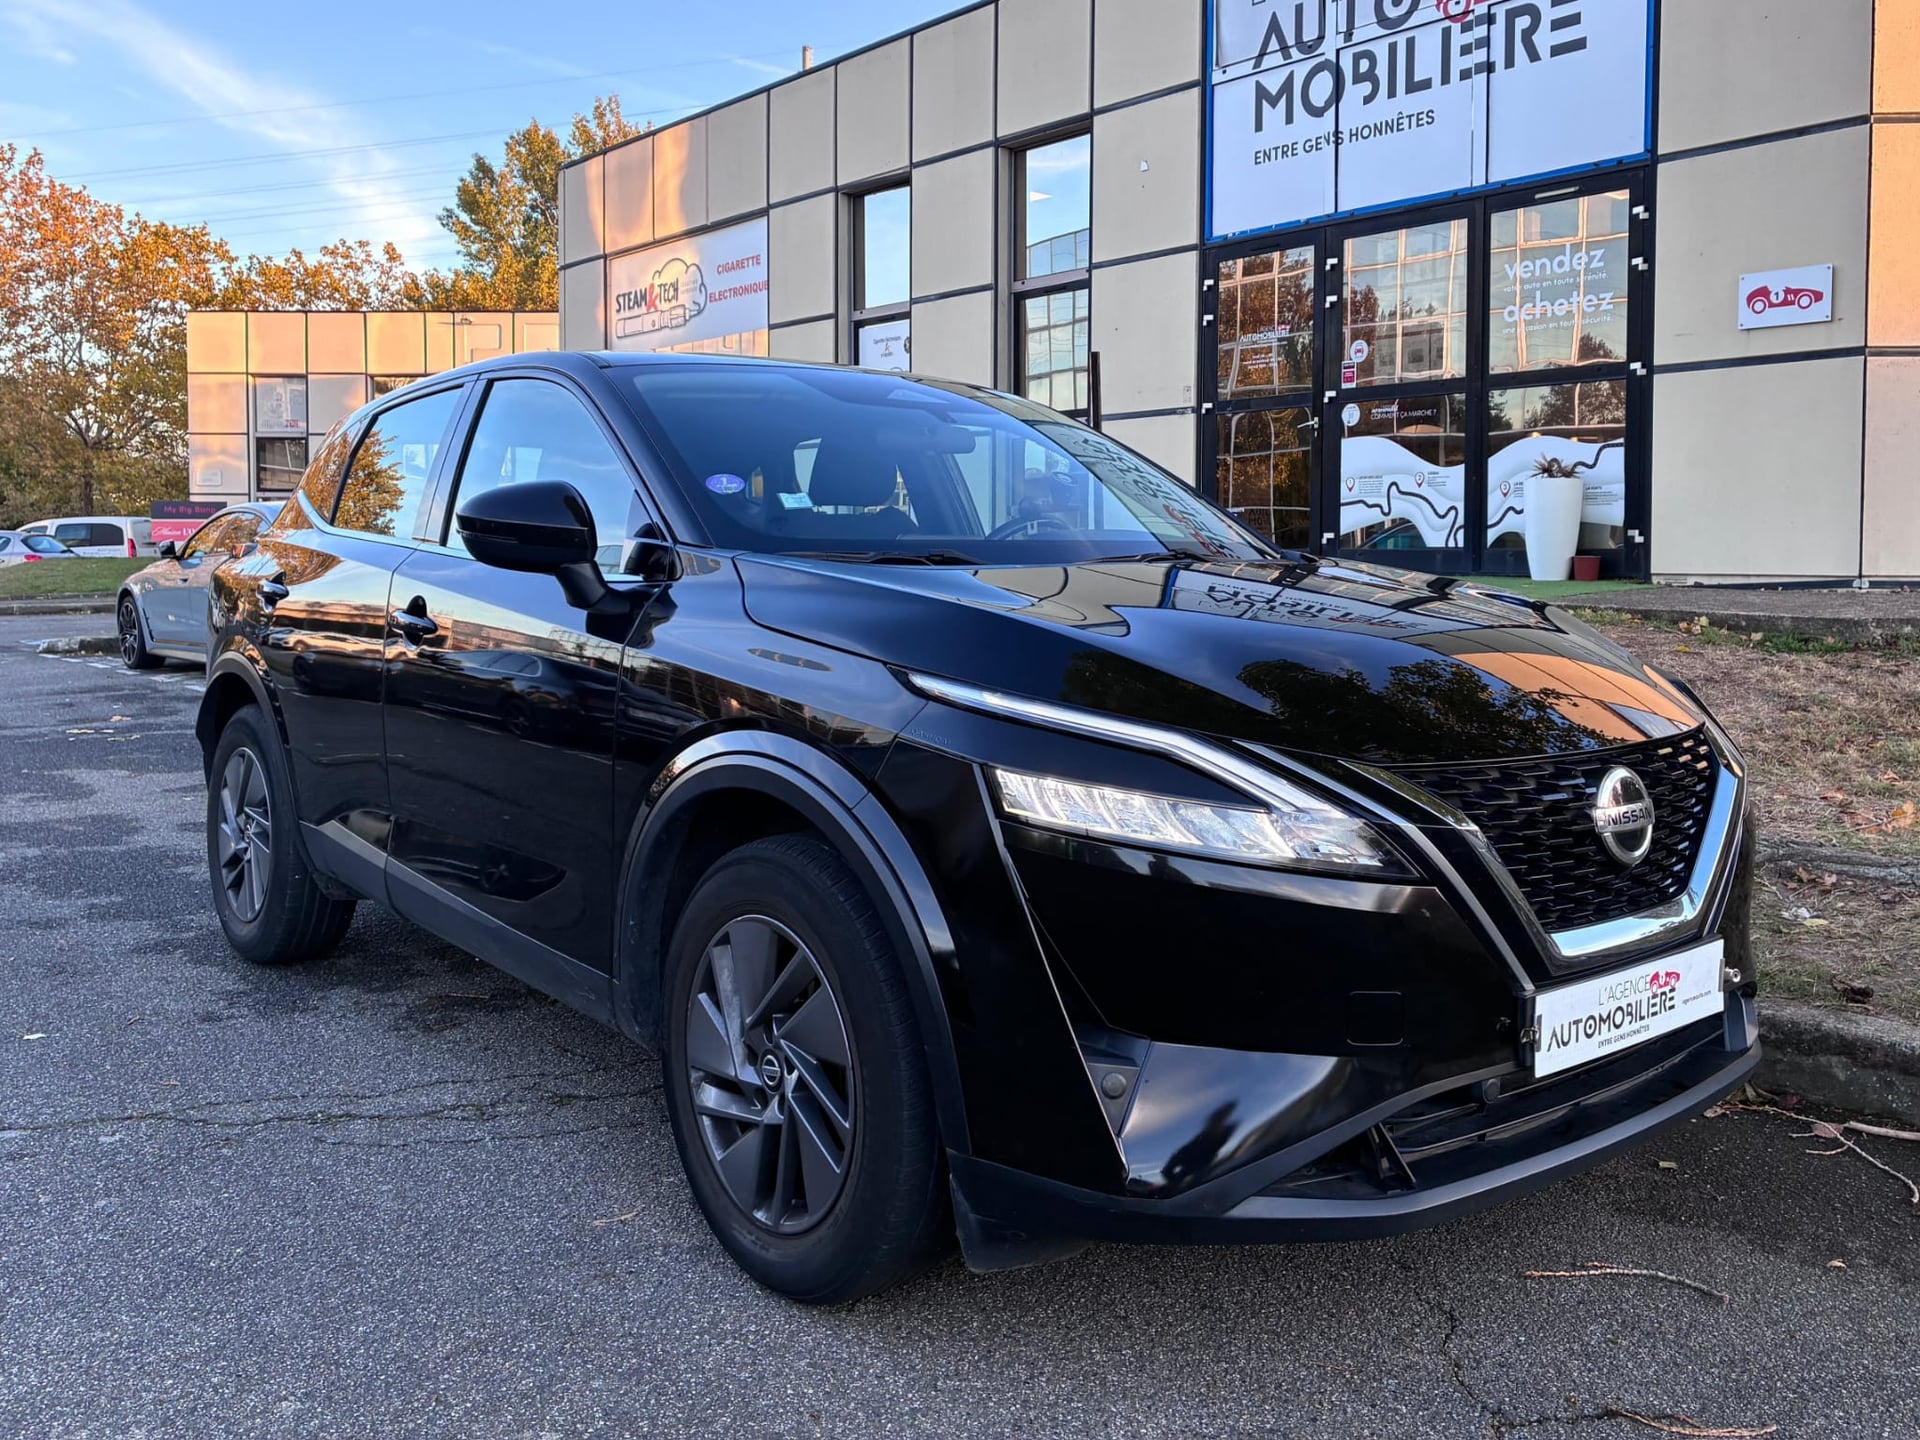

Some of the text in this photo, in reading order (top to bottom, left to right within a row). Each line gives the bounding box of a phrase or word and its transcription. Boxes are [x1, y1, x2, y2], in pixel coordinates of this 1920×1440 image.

[1254, 109, 1435, 165] ENTRE GENS HONNÊTES
[716, 254, 761, 275] CIGARETTE
[1504, 244, 1605, 280] vendez
[709, 280, 769, 302] ELECTRONIQUE
[1774, 292, 1779, 300] 1
[1504, 291, 1614, 322] achetez
[1607, 806, 1651, 827] NISSAN
[1599, 974, 1650, 1005] L'AGENCE
[1598, 1034, 1612, 1049] ENTRE
